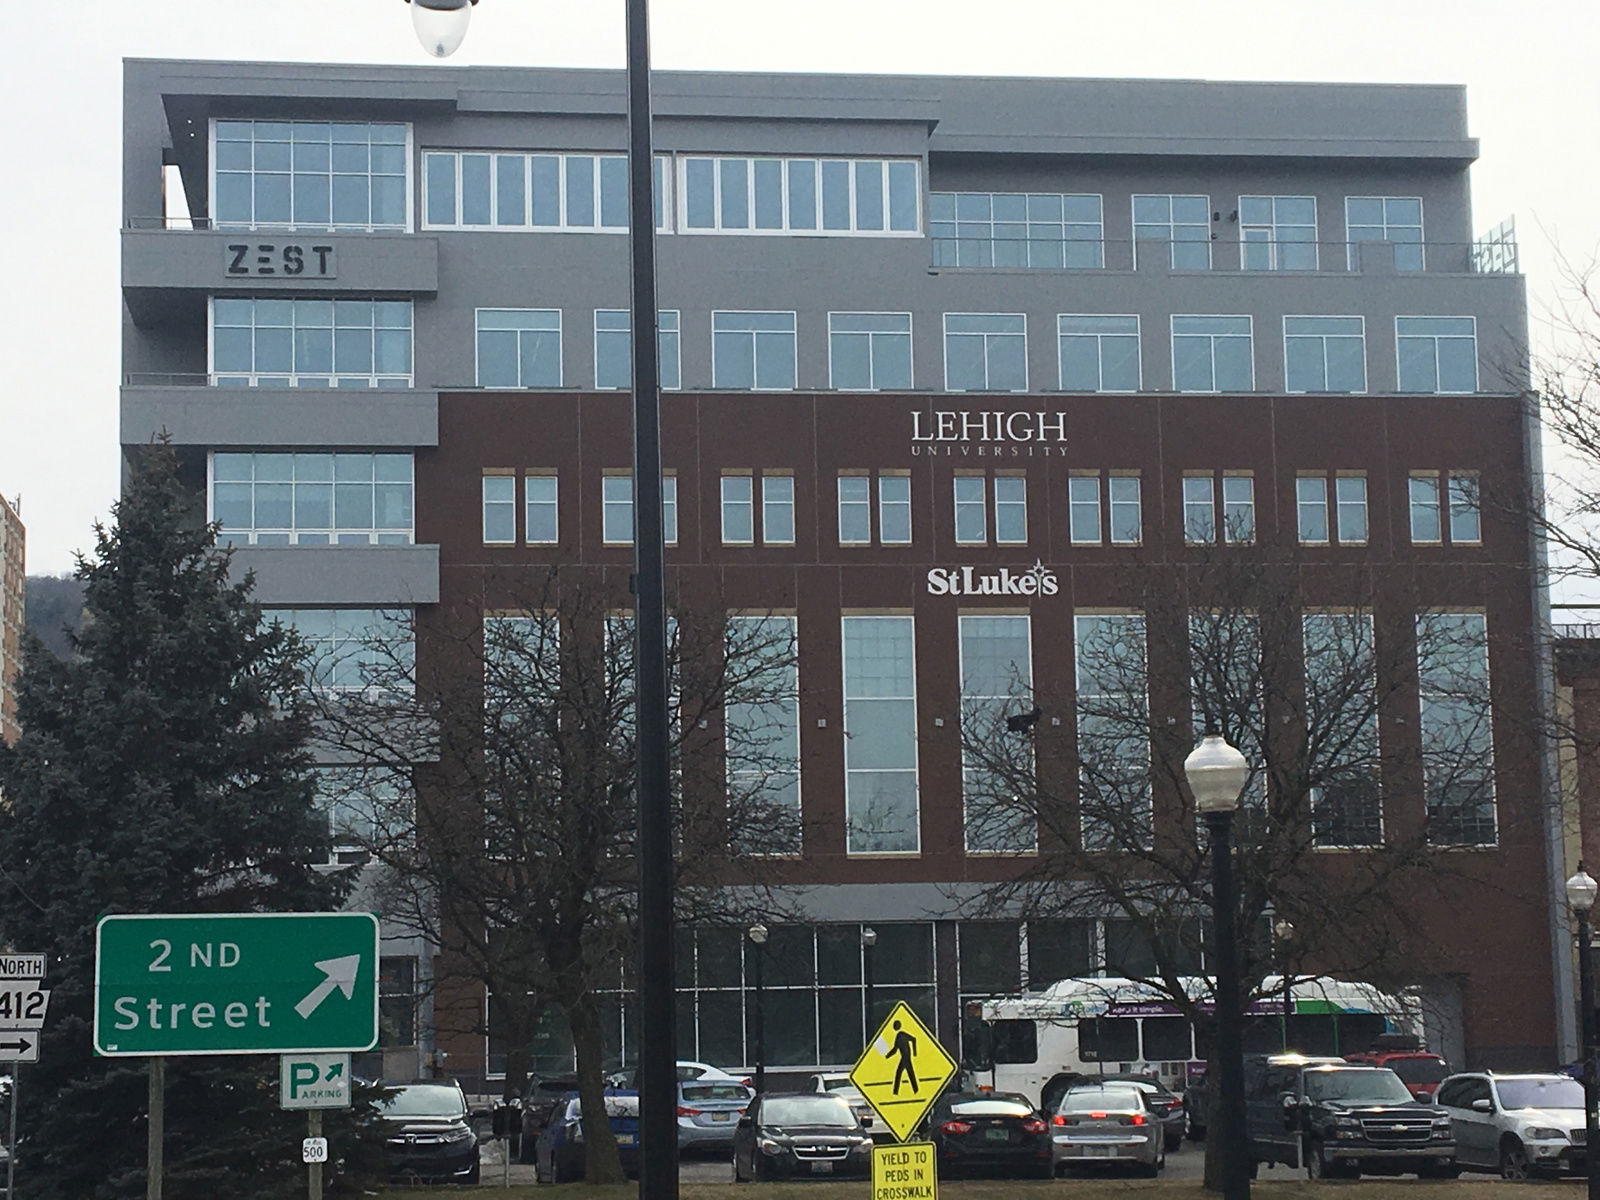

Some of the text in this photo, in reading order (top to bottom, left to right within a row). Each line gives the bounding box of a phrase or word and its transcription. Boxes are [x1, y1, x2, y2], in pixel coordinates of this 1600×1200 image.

[227, 244, 333, 275] ZEST
[910, 410, 1068, 442] LEHIGH
[910, 446, 1069, 457] UNIVERSITY
[0, 958, 42, 975] NORTH
[148, 938, 241, 972] 2 ND
[0, 991, 45, 1020] 412
[113, 996, 272, 1031] Street
[289, 1062, 343, 1100] PARKING
[303, 1146, 323, 1158] 500
[881, 1150, 927, 1166] YIELD TO
[885, 1169, 924, 1183] PEDS IN
[876, 1185, 933, 1200] CROSSWALK
